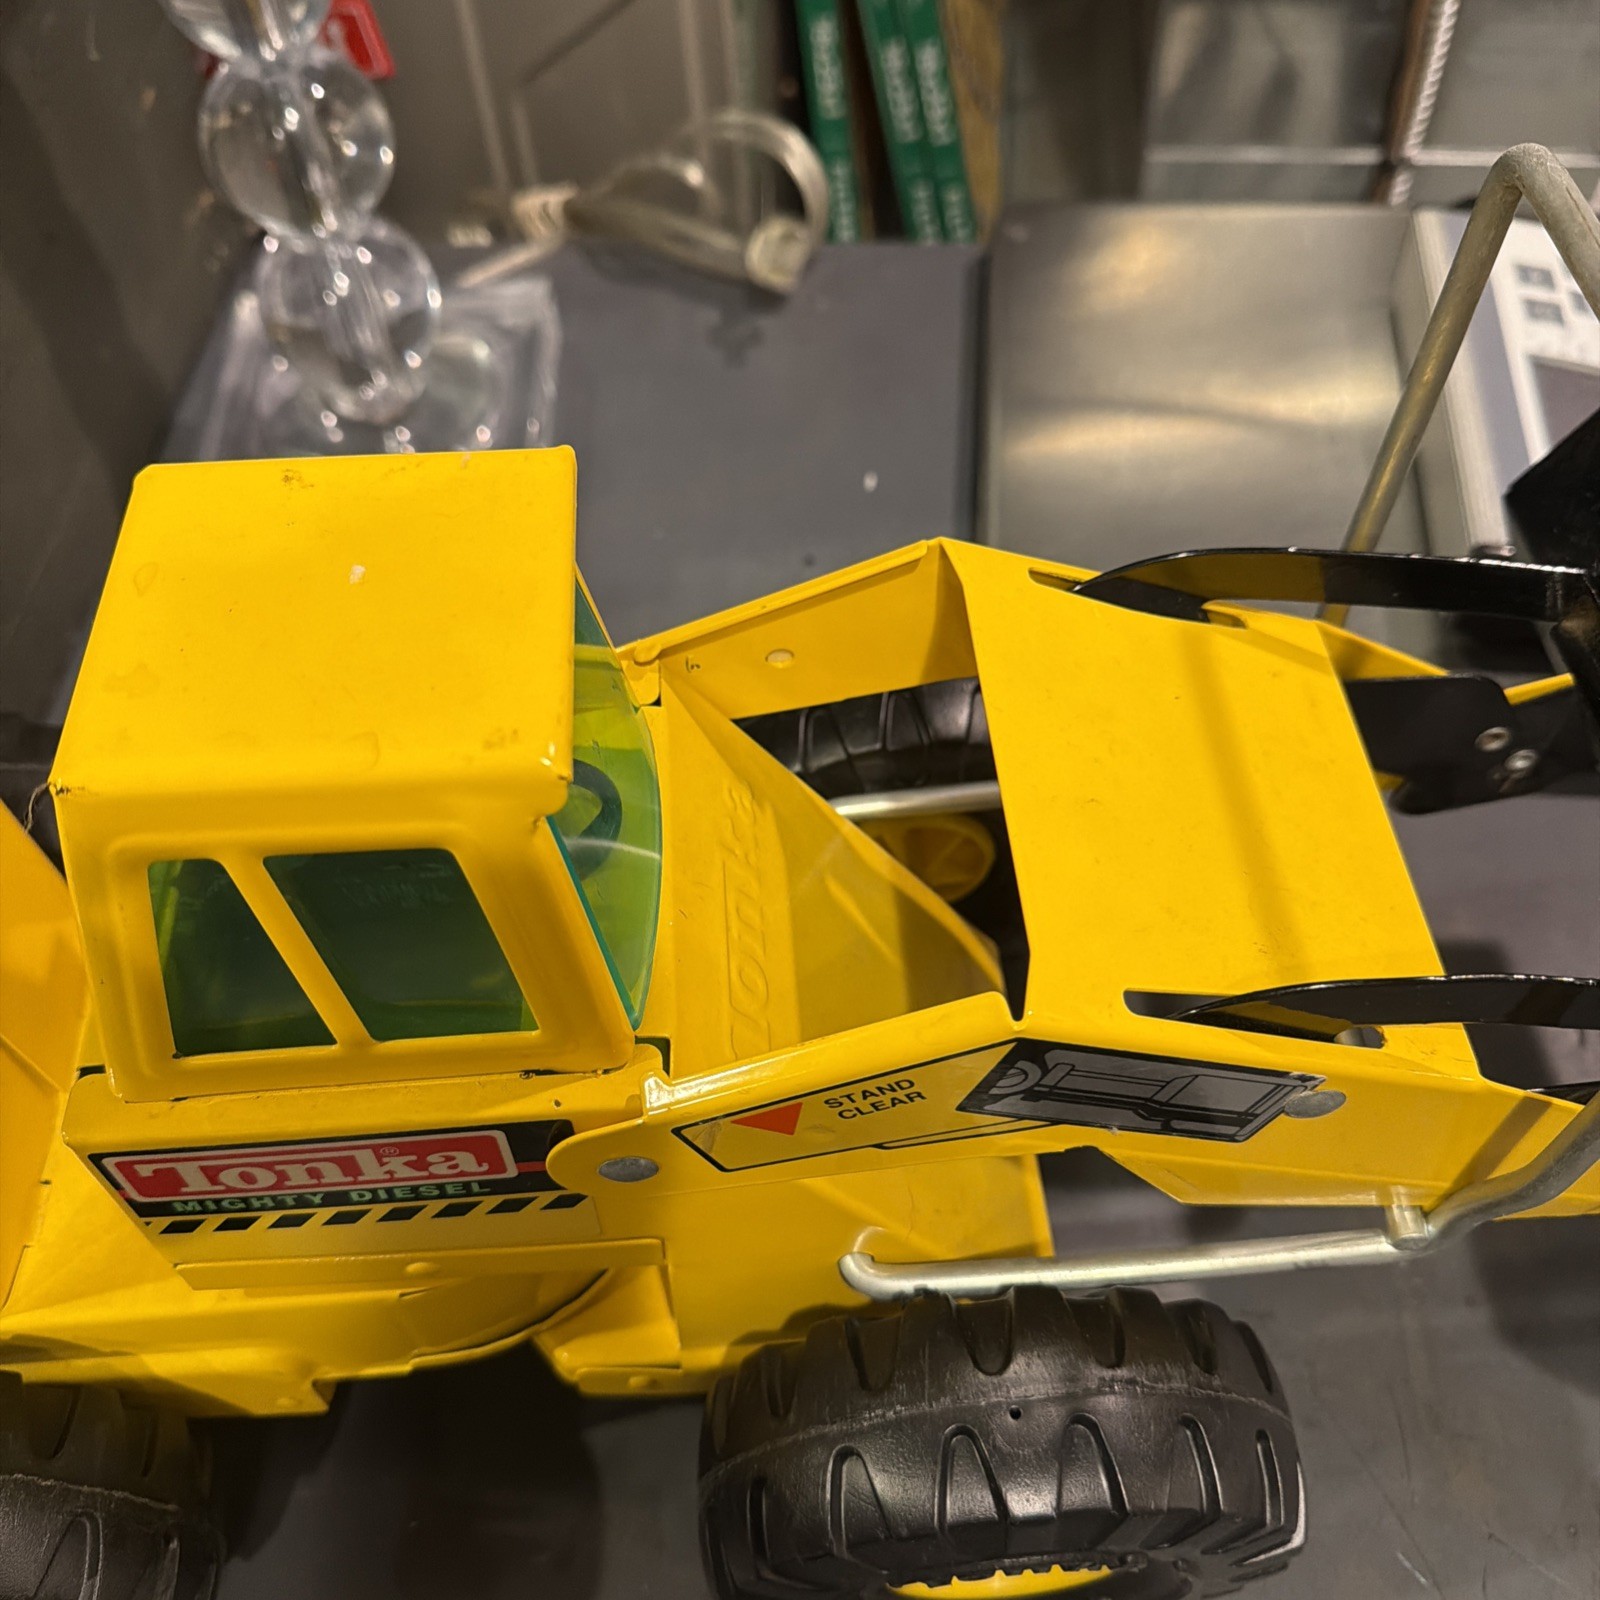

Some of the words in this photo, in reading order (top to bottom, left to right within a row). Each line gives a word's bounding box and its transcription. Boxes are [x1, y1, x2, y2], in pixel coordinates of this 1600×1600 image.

[824, 1078, 916, 1109] STAND
[837, 1091, 928, 1120] CLEAR
[172, 1193, 326, 1213] MIGHTY
[349, 1182, 492, 1203] DIESEL
